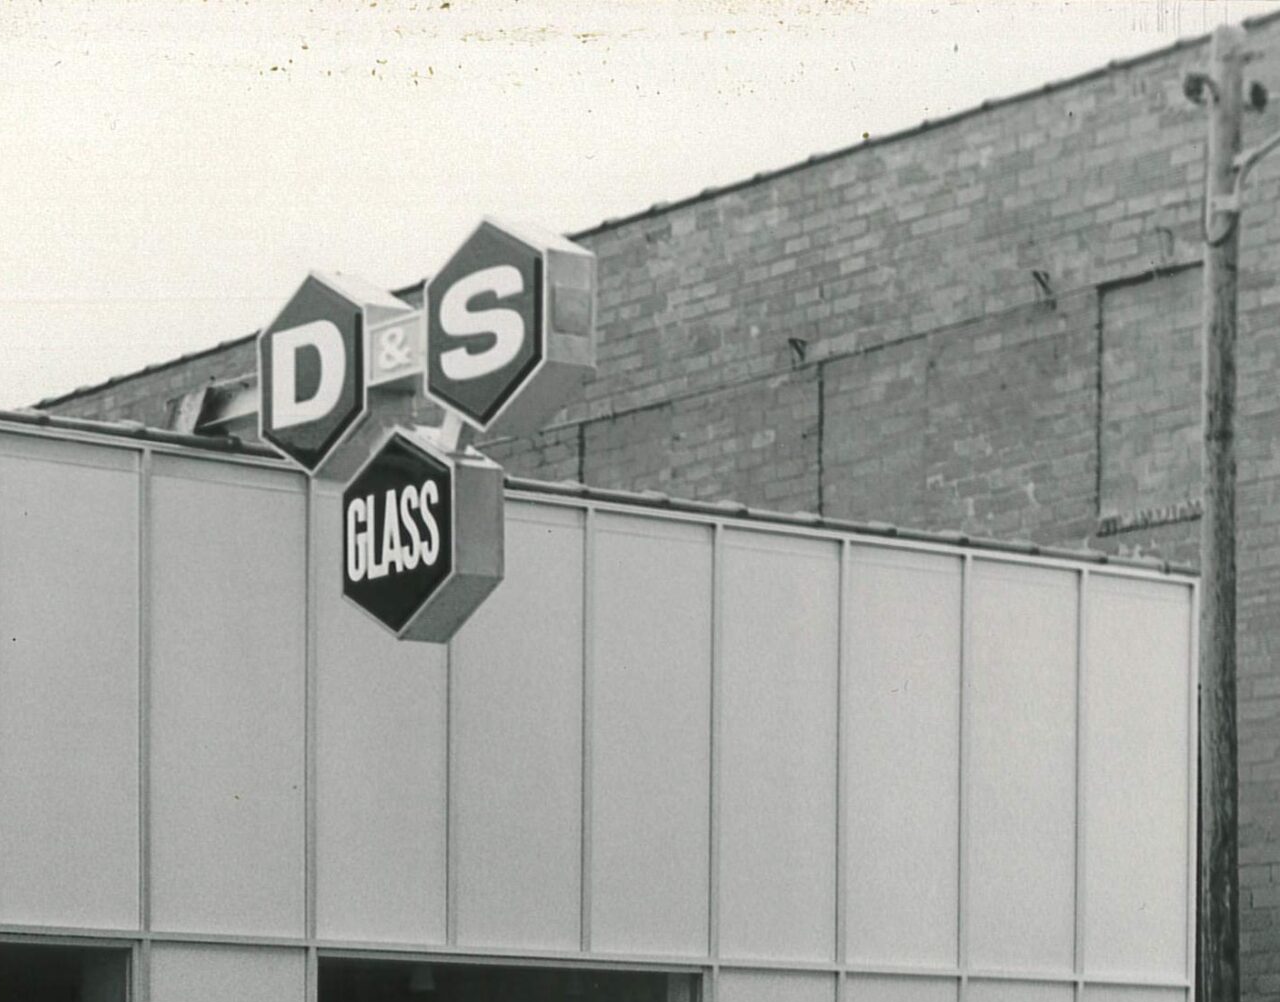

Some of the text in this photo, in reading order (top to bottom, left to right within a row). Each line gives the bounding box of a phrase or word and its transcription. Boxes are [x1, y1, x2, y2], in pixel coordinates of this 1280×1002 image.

[272, 265, 525, 430] D & S
[347, 479, 440, 582] GLASS
